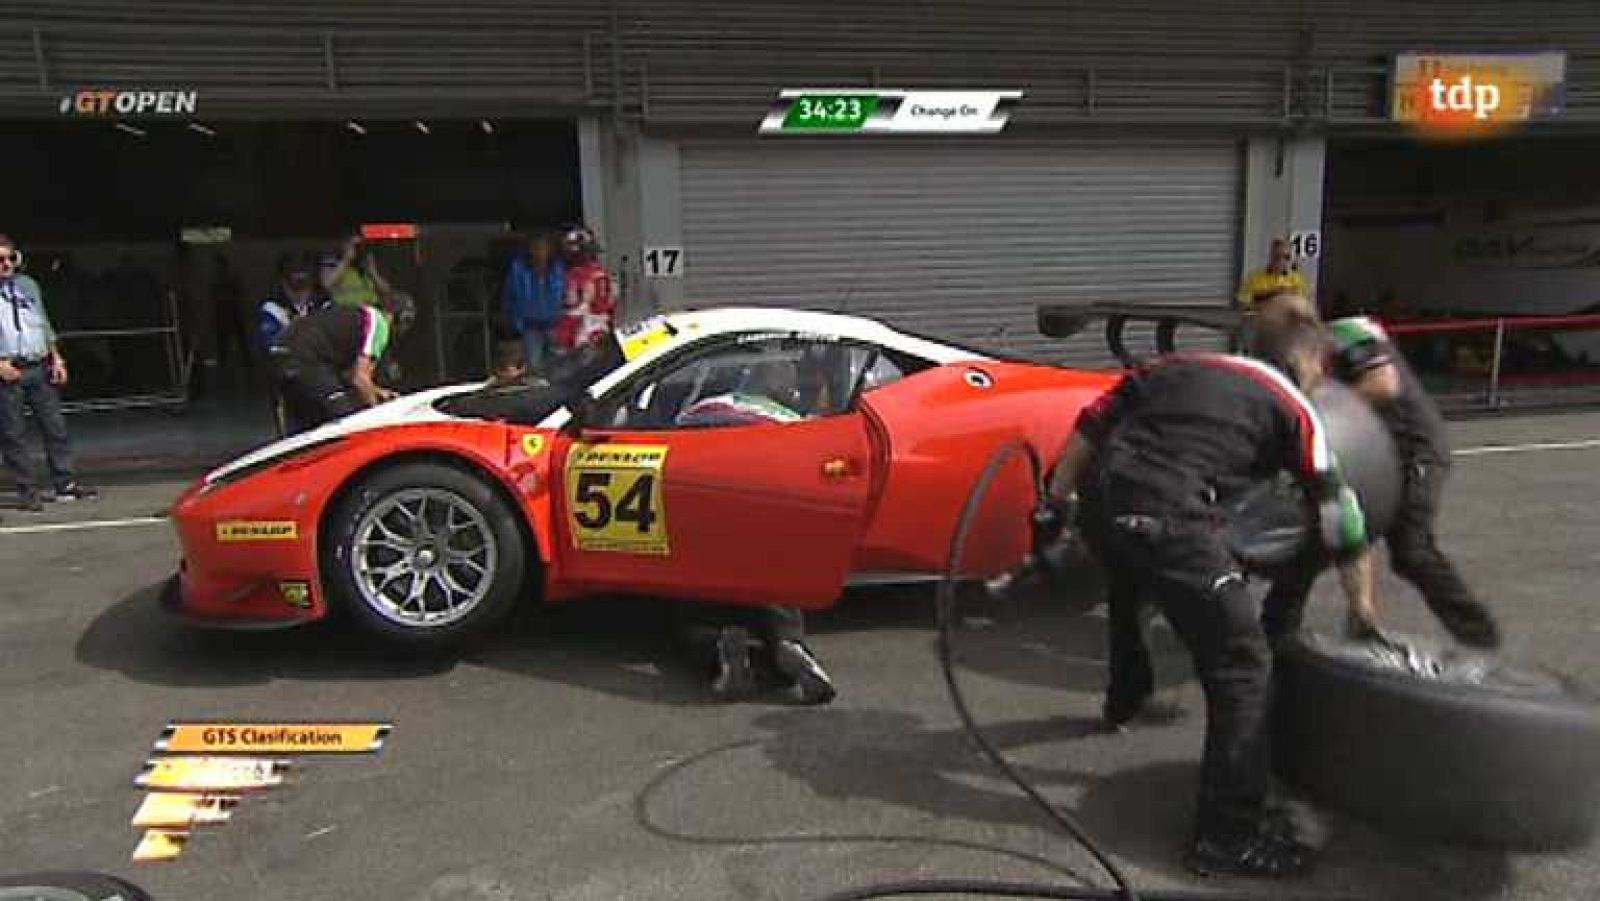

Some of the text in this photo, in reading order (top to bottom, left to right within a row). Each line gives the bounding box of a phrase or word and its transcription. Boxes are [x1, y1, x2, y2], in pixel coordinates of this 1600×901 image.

[1290, 233, 1318, 258] 16
[646, 249, 680, 274] 17
[573, 472, 657, 533] 54
